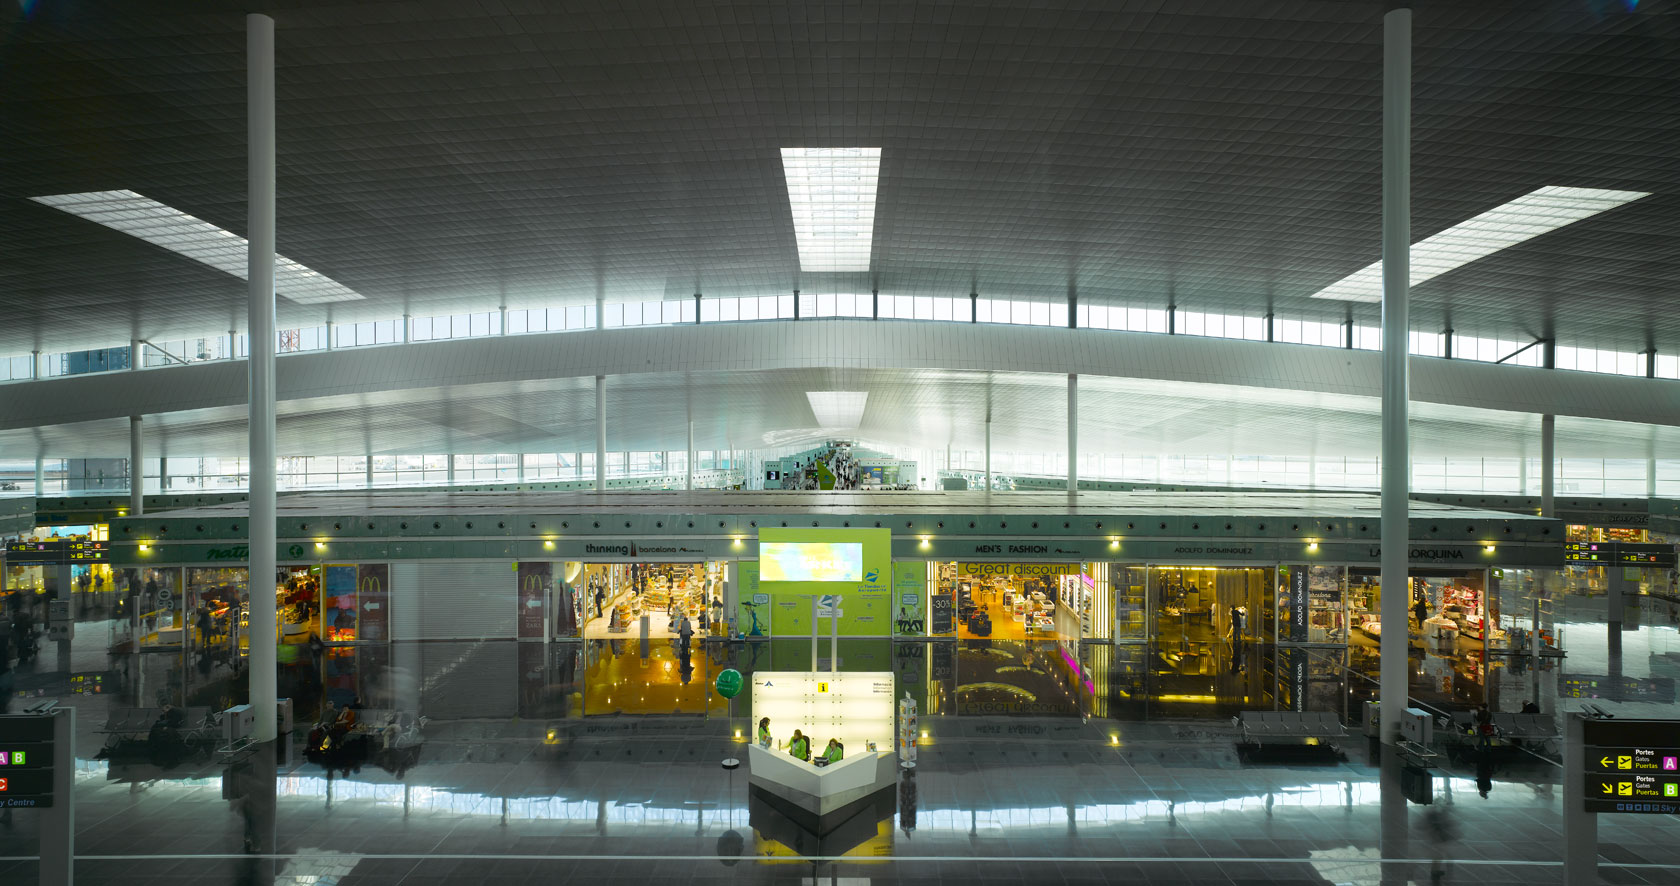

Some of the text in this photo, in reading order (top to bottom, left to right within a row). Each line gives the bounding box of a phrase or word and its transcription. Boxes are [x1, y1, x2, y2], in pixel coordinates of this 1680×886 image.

[976, 545, 1002, 553] MEN'S
[1370, 548, 1464, 559] LA LORQUINA
[966, 562, 1071, 575] Great discount
[15, 752, 22, 762] B
[1666, 758, 1674, 768] A
[1667, 785, 1674, 794] B
[1661, 804, 1676, 813] Sky
